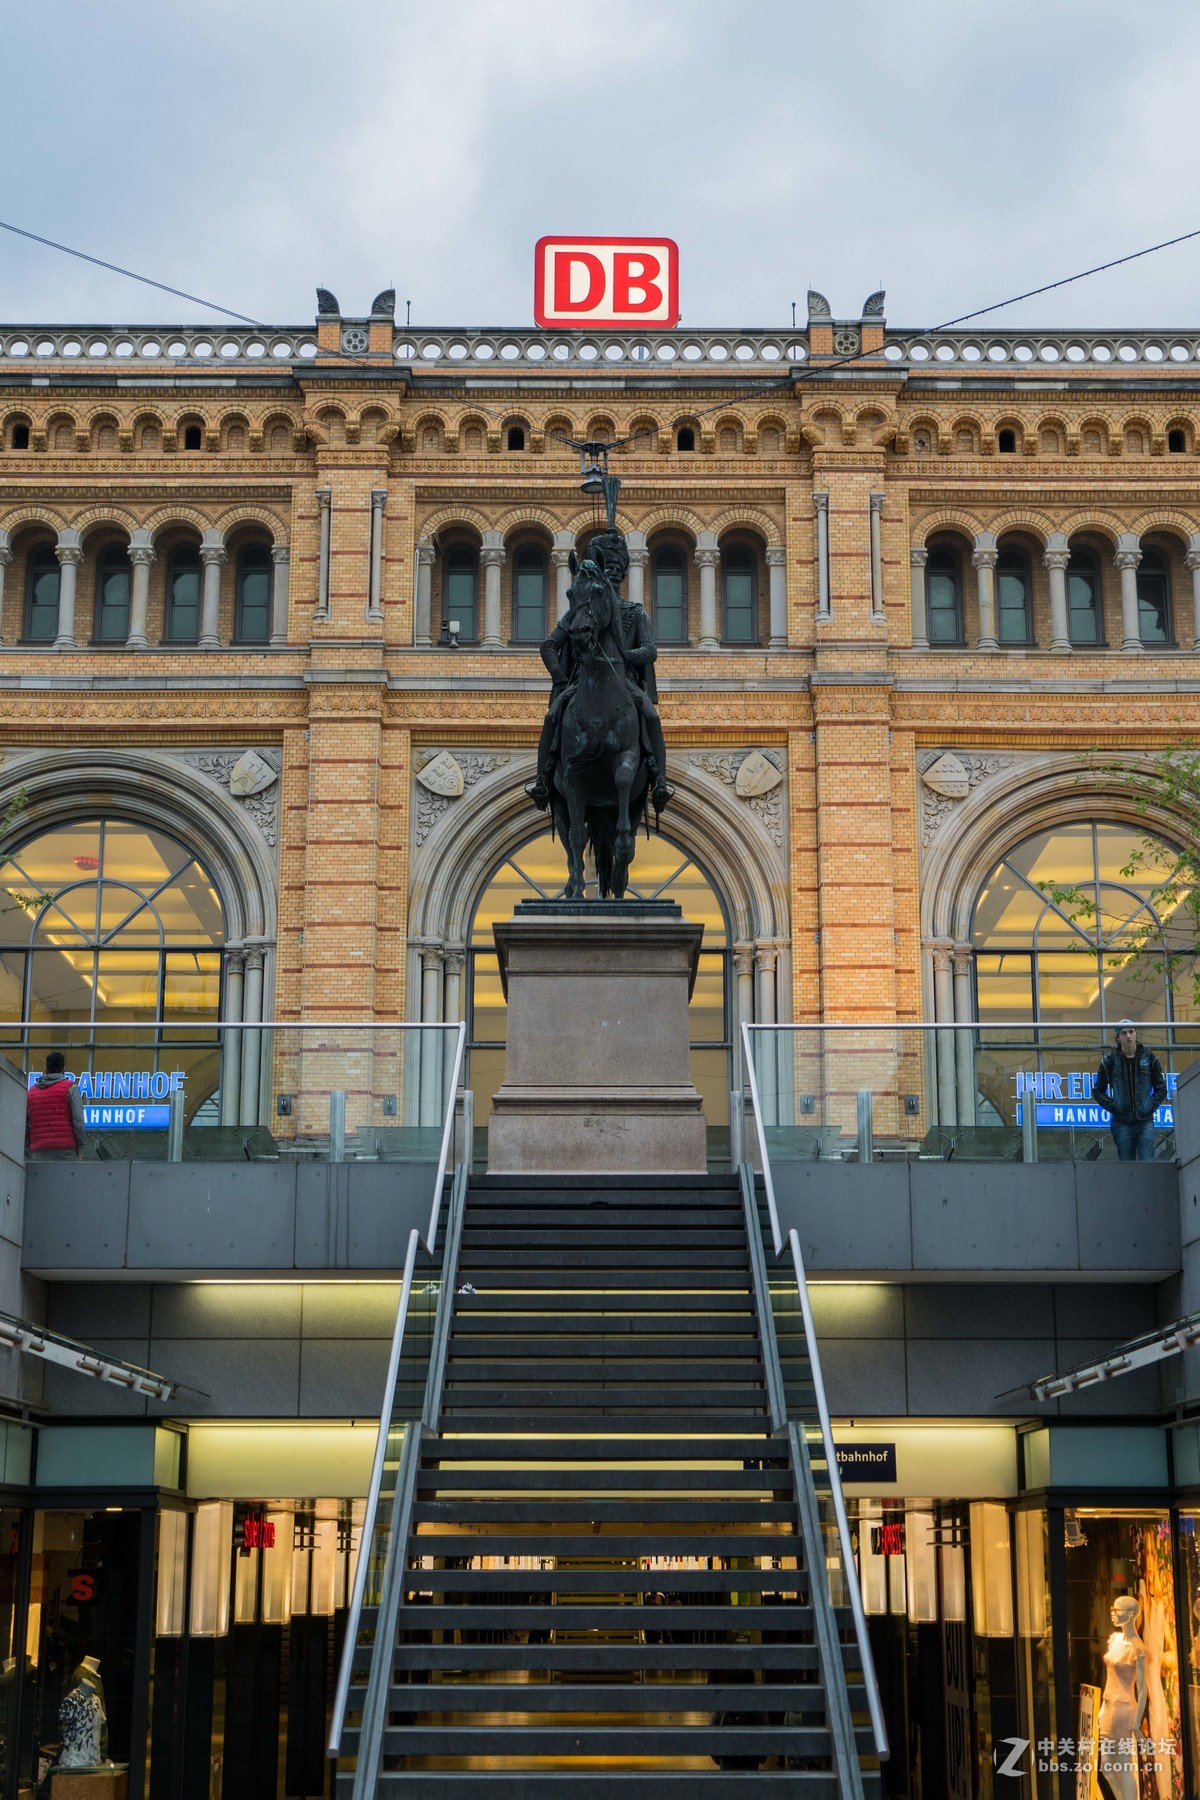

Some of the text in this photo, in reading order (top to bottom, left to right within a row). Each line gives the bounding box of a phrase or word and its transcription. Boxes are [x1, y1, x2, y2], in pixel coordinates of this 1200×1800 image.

[554, 252, 662, 313] DB
[1016, 1072, 1062, 1099] IHR
[72, 1574, 95, 1601] S
